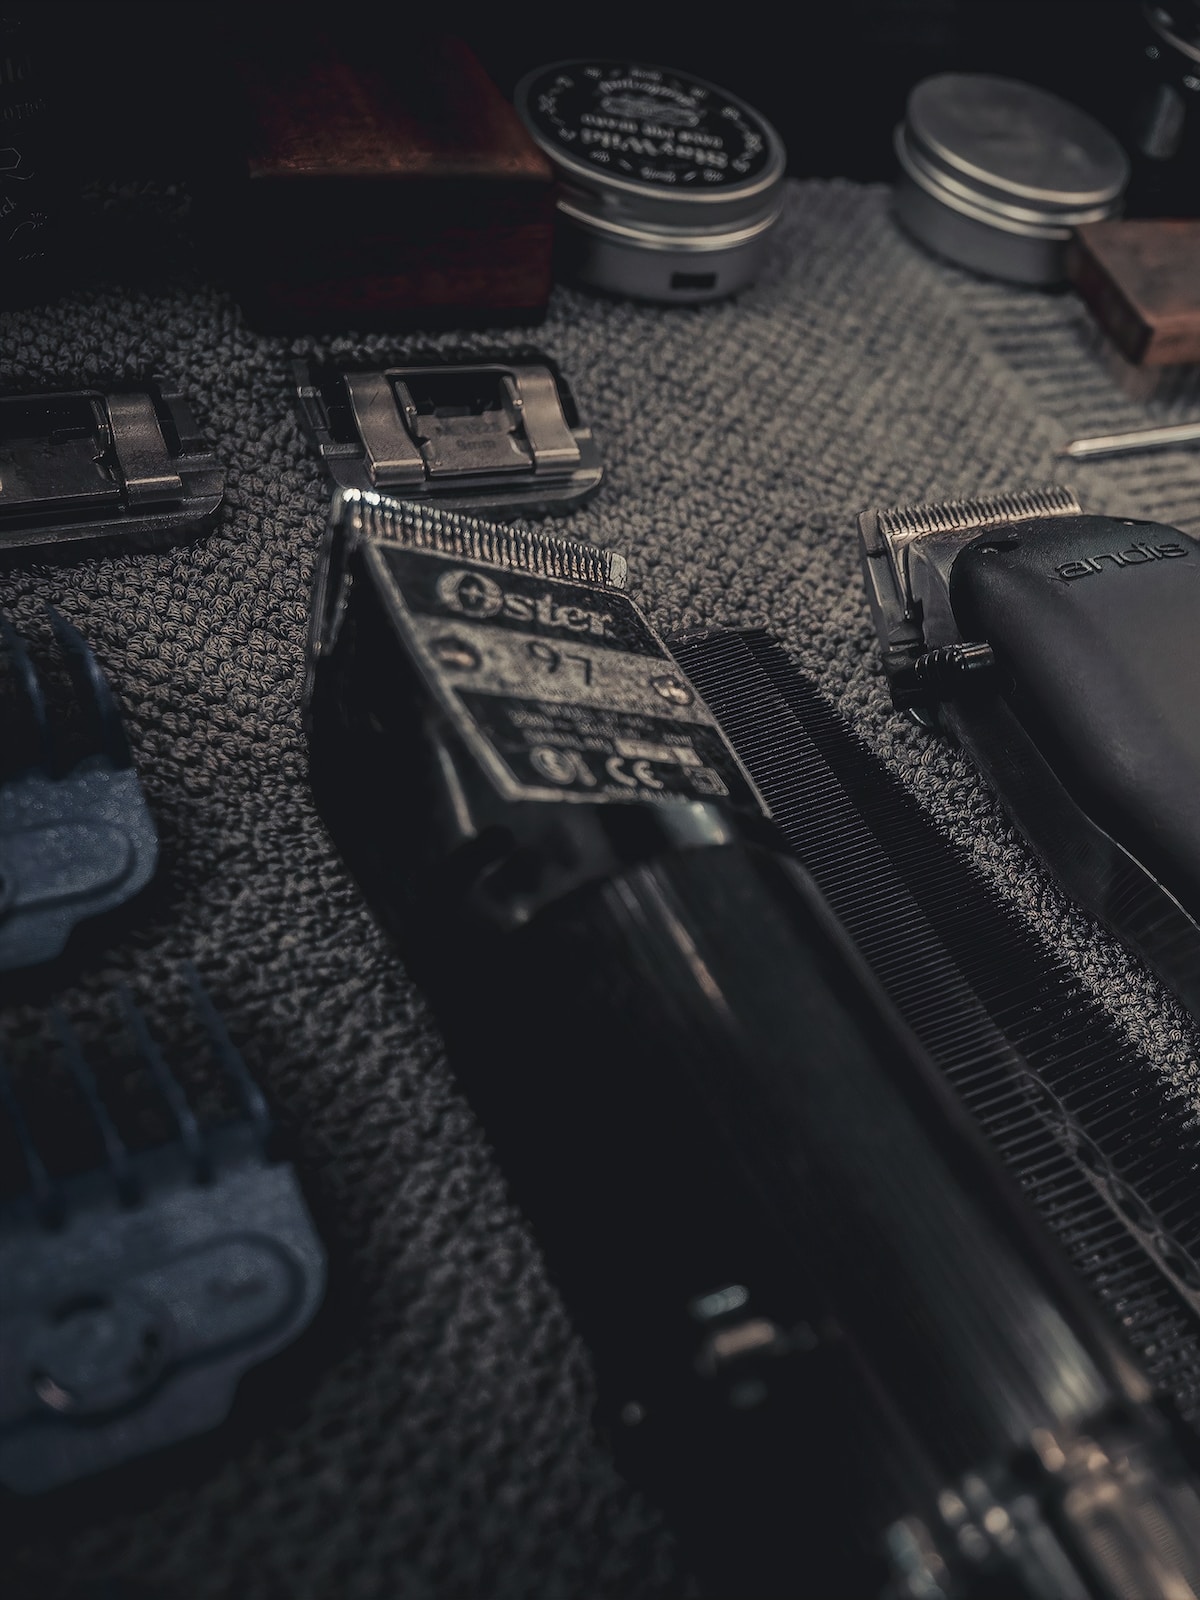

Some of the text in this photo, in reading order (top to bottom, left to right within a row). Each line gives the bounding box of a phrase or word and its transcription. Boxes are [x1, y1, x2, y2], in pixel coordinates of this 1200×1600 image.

[1055, 542, 1189, 580] andis
[436, 569, 615, 638] Oster
[526, 640, 593, 686] 97
